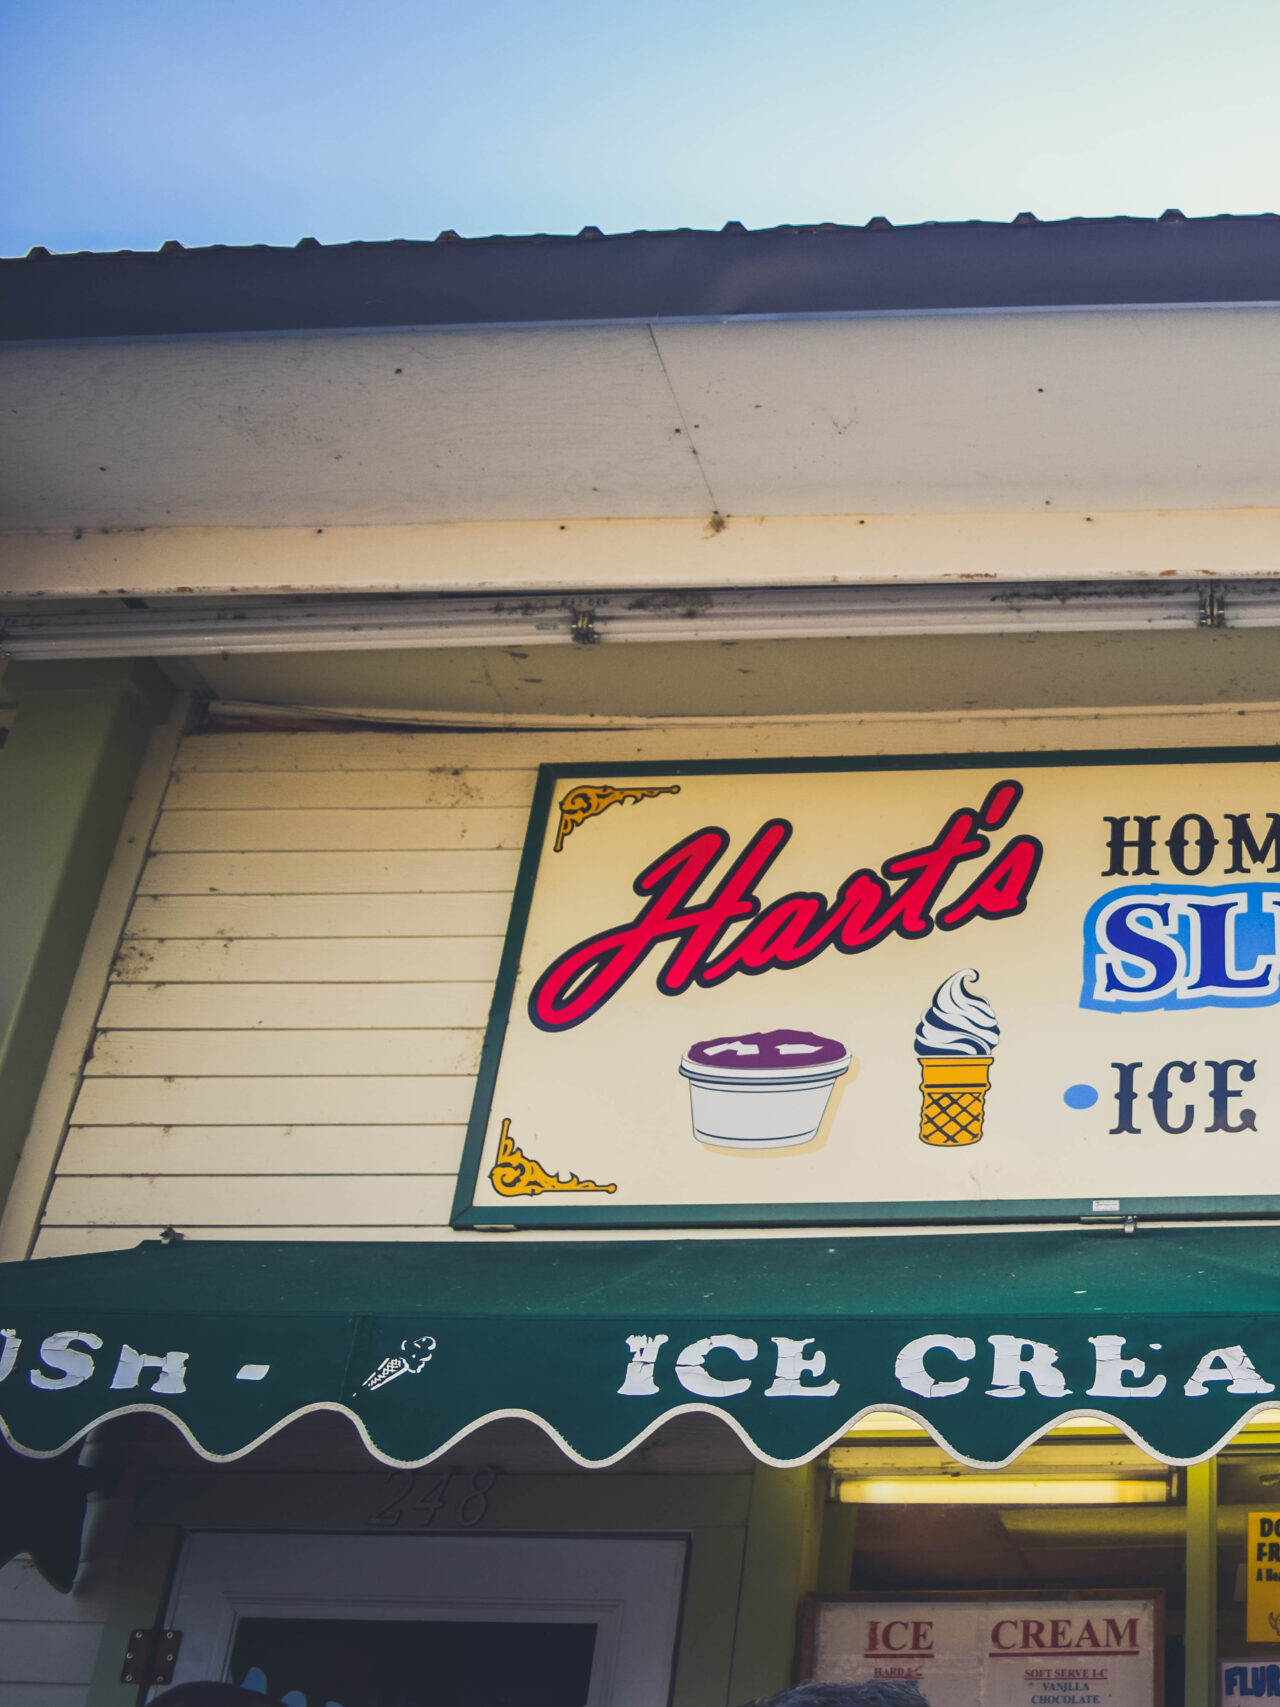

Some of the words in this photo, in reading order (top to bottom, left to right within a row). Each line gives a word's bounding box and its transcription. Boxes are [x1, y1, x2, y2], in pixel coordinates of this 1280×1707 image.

[528, 779, 1043, 1032] Hart's
[1108, 1059, 1258, 1135] ICE
[617, 1333, 840, 1398] ICE
[368, 1466, 497, 1528] 248
[1256, 1568, 1263, 1582] A
[864, 1620, 934, 1652] ICE
[991, 1618, 1140, 1650] CREAM
[874, 1667, 905, 1678] HARD
[1024, 1668, 1051, 1679] SOFT
[1054, 1668, 1089, 1679] SERVE
[1031, 1695, 1100, 1705] CHOCOLATE
